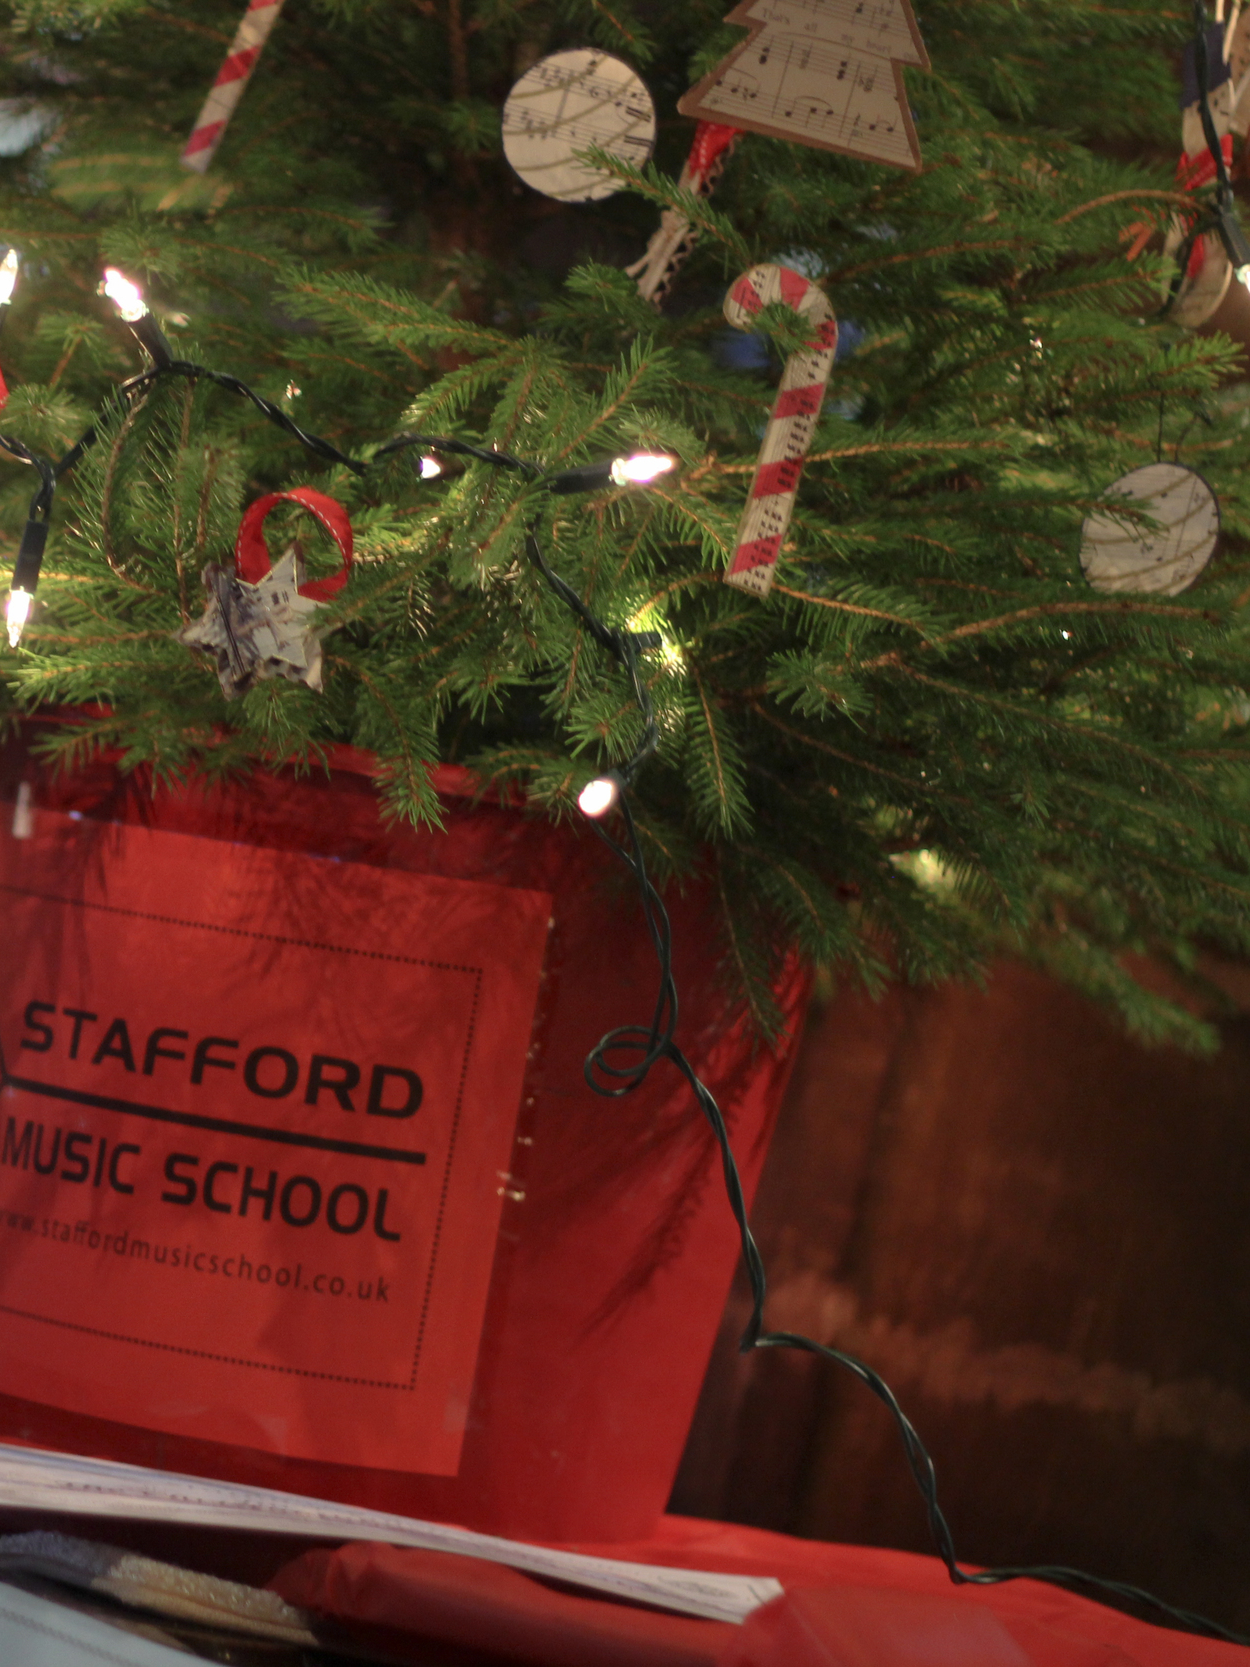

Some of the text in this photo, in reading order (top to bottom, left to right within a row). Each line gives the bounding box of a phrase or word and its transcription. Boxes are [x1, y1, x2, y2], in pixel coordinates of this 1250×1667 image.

[20, 999, 424, 1120] STAFFORD
[2, 1115, 401, 1242] MUSIC SCHOOL
